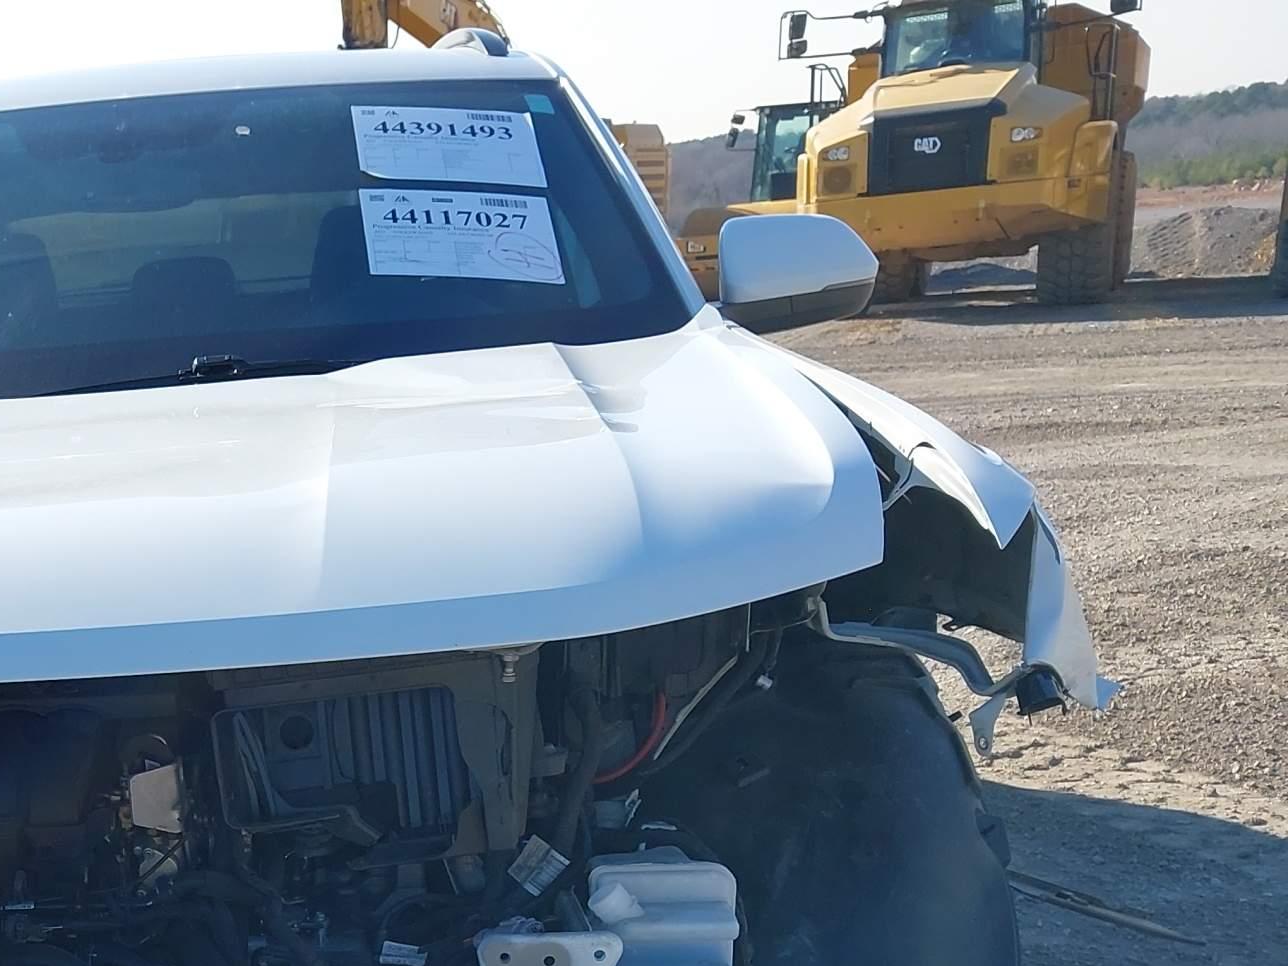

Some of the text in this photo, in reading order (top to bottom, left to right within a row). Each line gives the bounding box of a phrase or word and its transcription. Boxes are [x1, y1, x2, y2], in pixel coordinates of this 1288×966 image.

[374, 120, 513, 141] 44391493
[914, 136, 937, 152] CAT
[383, 207, 528, 230] 44117027
